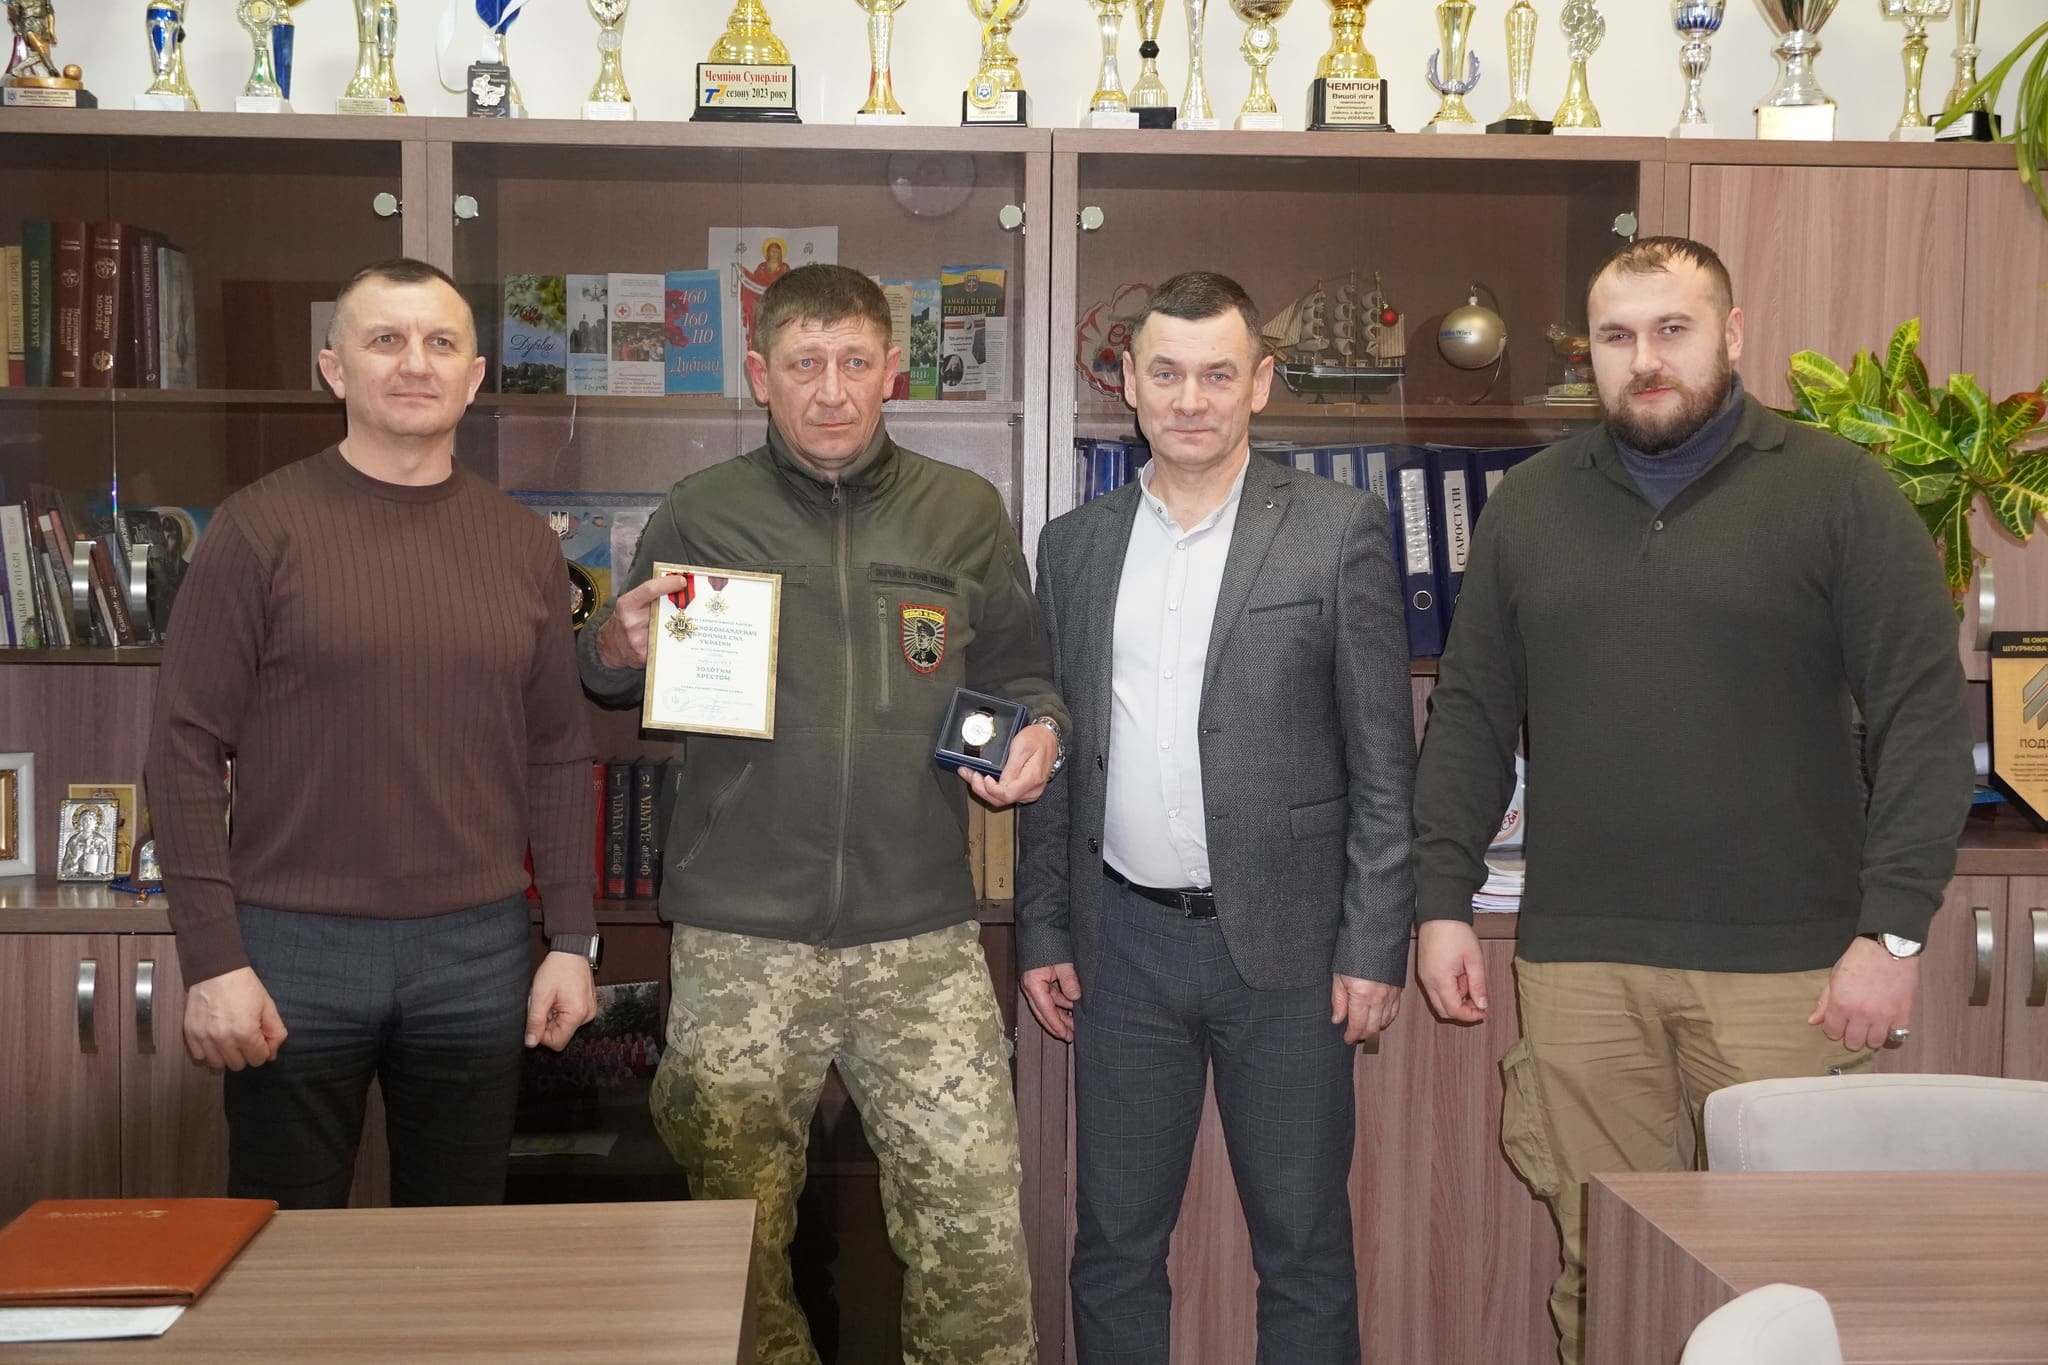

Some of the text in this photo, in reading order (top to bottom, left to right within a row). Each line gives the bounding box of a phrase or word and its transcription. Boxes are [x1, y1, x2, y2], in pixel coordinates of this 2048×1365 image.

[705, 70, 788, 85] Чемпіон Суперліги
[1326, 83, 1379, 91] ЧЕМПІОН
[726, 88, 787, 101] сезону 2023 року
[679, 289, 707, 305] 460
[943, 305, 997, 314] ТЕРНОПІЛЛЯ
[682, 312, 708, 327] 160
[31, 308, 40, 348] ЗАКОН
[691, 329, 714, 344] 110
[1451, 487, 1466, 566] СТАРОСТАТИ
[696, 666, 732, 674] ЗОЛОТИМ
[696, 673, 730, 681] ХРЕСТОМ
[2019, 738, 2048, 749] ПОД
[998, 876, 1004, 888] 2
